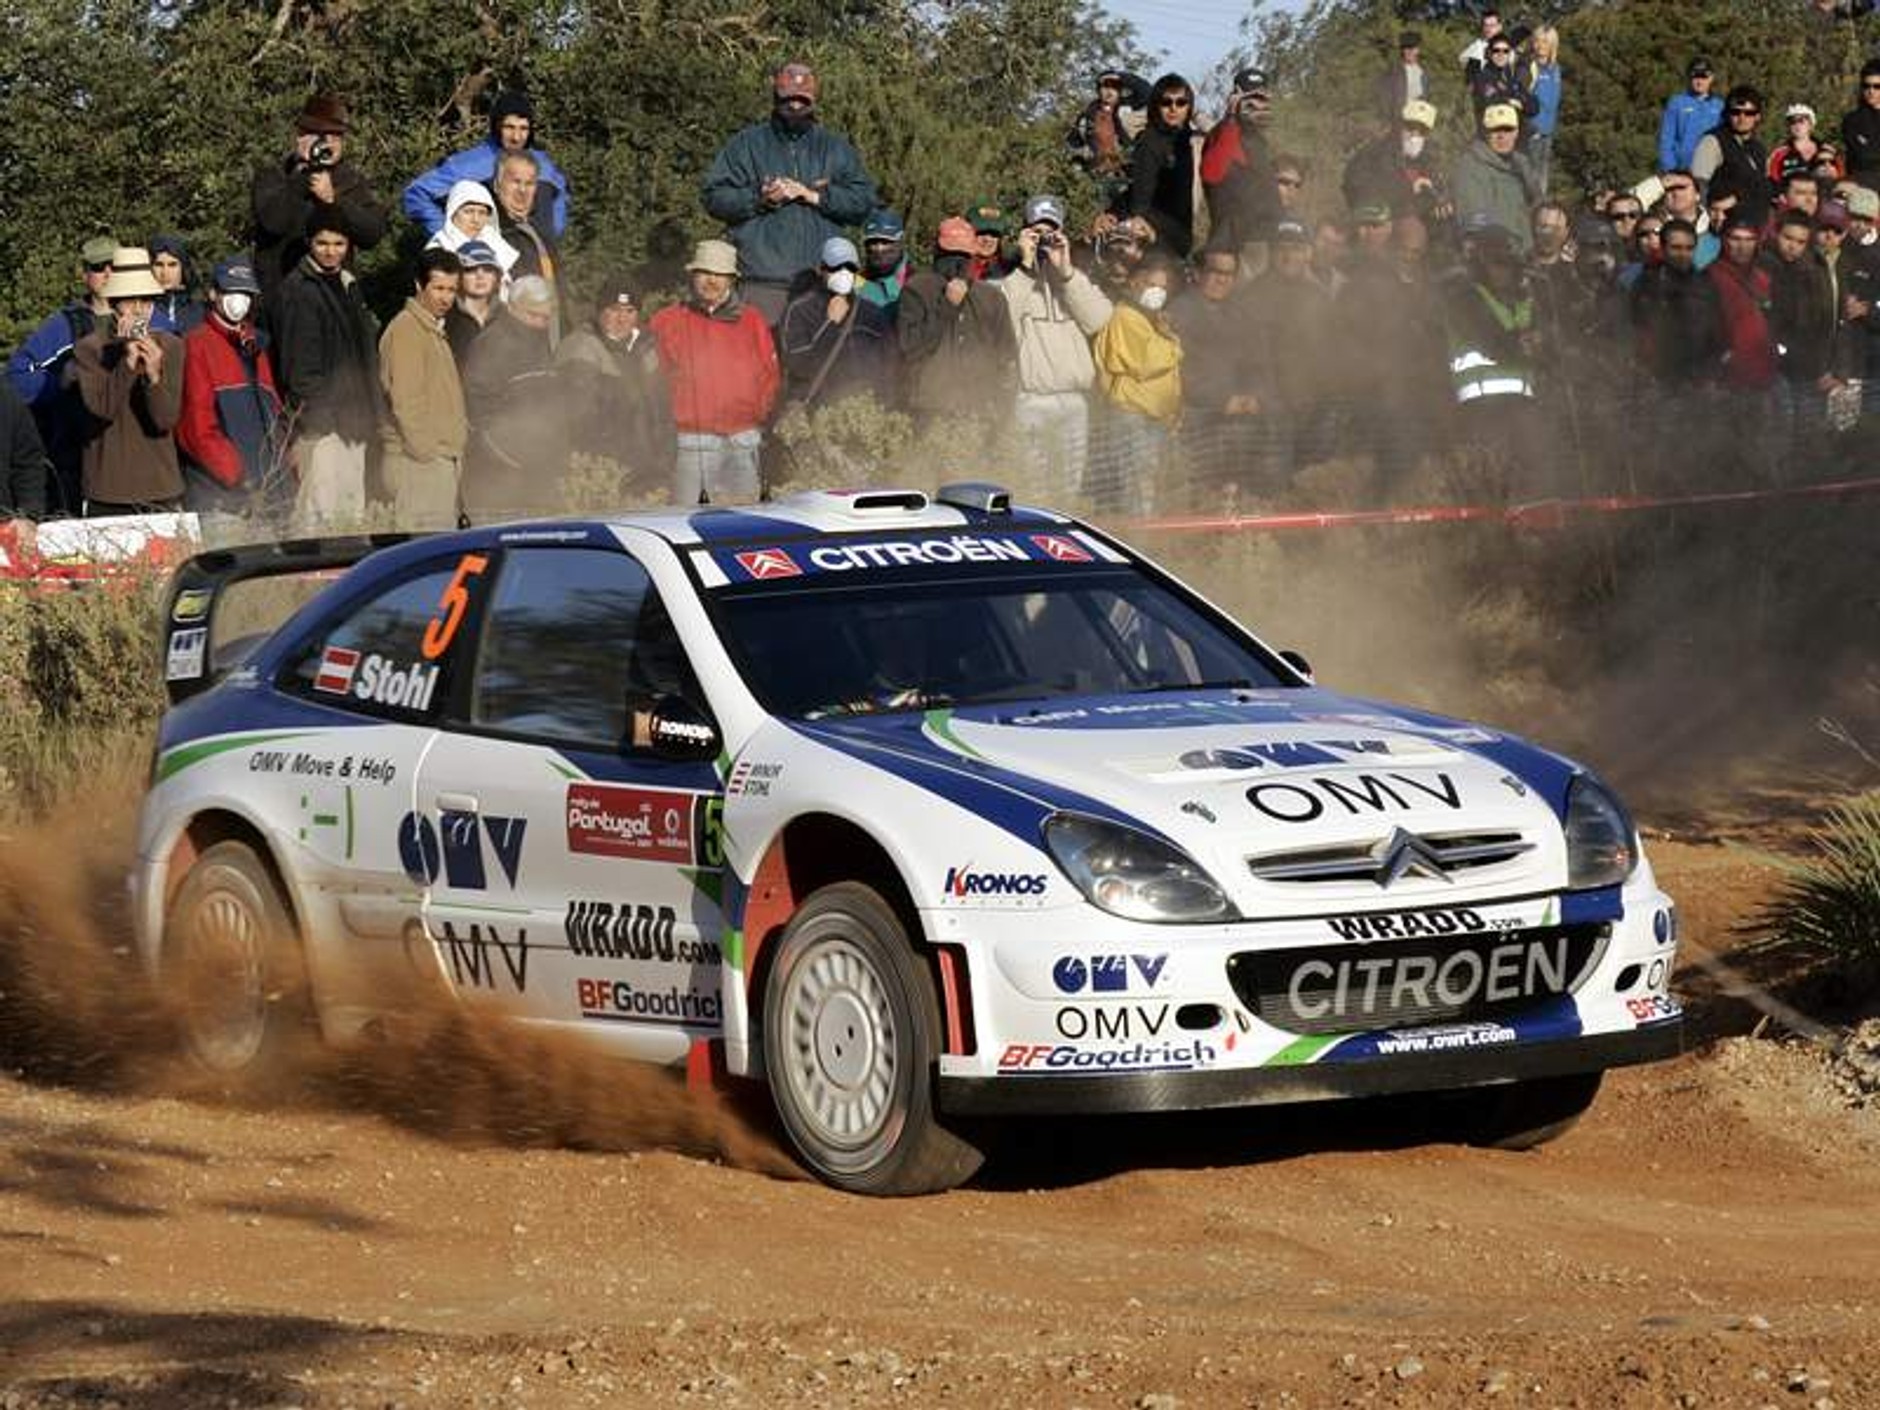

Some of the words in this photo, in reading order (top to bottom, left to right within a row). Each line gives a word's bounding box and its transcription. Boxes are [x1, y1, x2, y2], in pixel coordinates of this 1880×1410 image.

[809, 535, 1031, 571] CITROËN
[421, 553, 489, 660] 5
[354, 653, 440, 711] Stohl
[250, 751, 290, 773] OMV
[291, 754, 333, 777] Move
[339, 756, 353, 778] &
[358, 756, 396, 785] Help
[1245, 773, 1462, 823] OMV
[568, 808, 653, 838] Portugal
[1053, 953, 1170, 994] OMV
[1287, 930, 1568, 1020] CITROËN
[1055, 1003, 1169, 1039] OMV
[999, 1039, 1216, 1068] BFGoodrich
